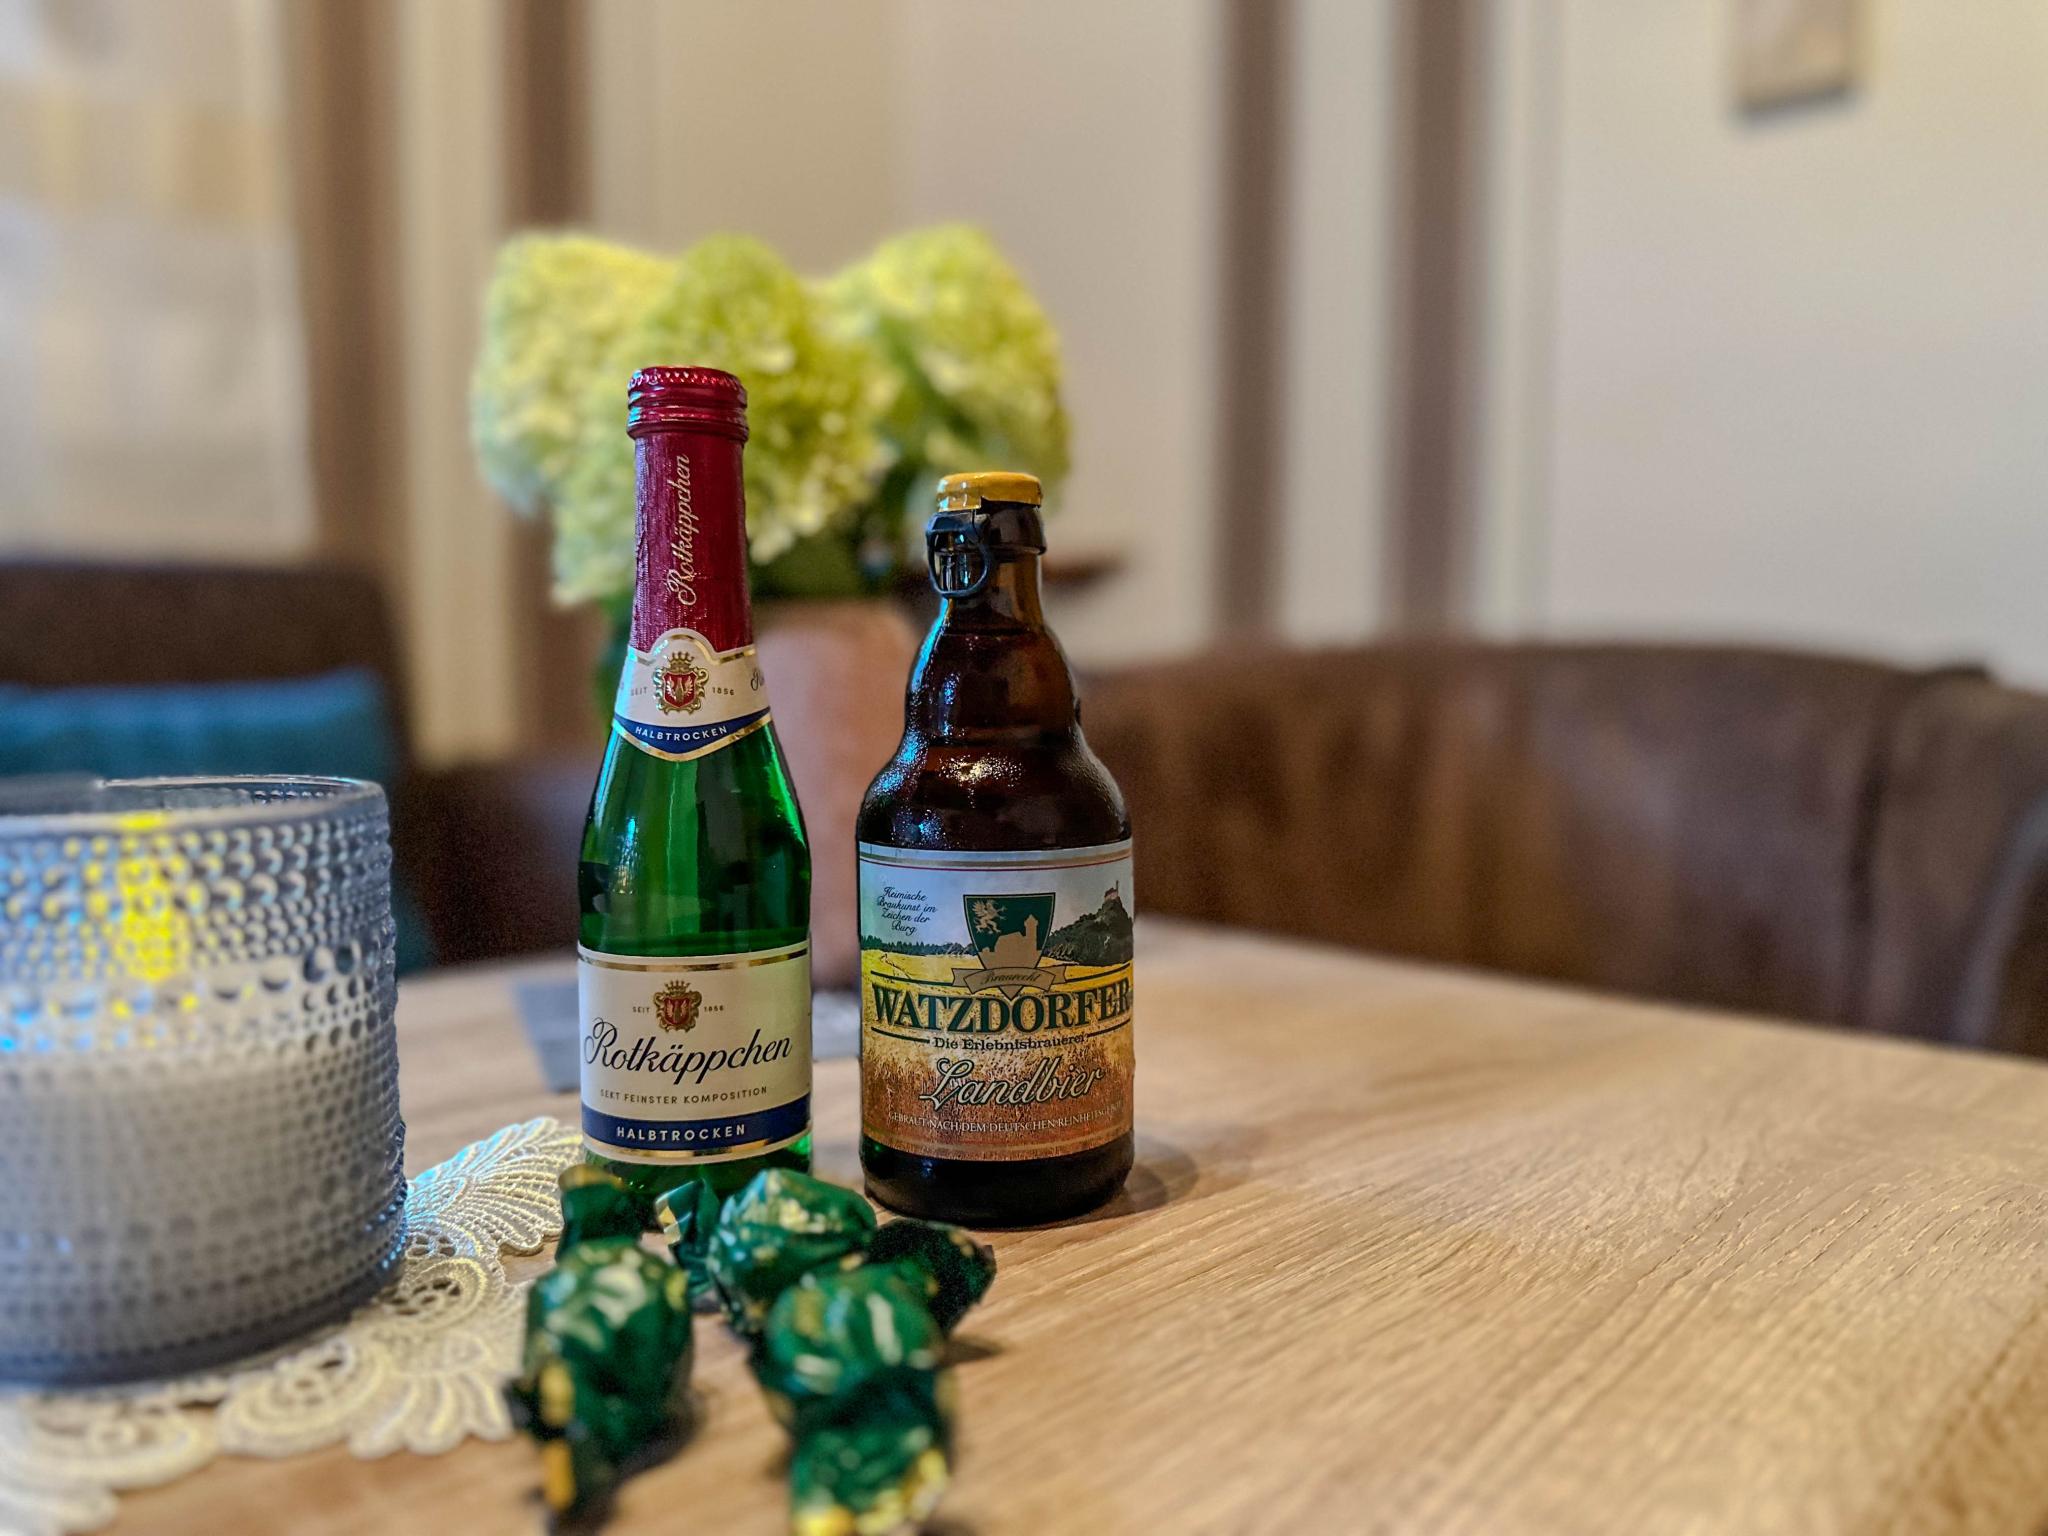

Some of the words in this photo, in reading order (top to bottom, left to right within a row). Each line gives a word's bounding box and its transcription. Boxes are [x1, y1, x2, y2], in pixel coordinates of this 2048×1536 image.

[667, 453, 702, 606] Rotkäppchen
[631, 686, 648, 696] SEIT
[635, 726, 728, 741] HALBTROCKEN
[884, 886, 928, 901] Heimische
[877, 896, 921, 911] Braukunst
[923, 903, 937, 913] im
[881, 907, 911, 921] Zeichen
[914, 911, 931, 923] der
[892, 920, 916, 936] Burg
[632, 1006, 650, 1014] SEIT
[871, 976, 1131, 1033] WATZDORFER
[584, 1017, 793, 1085] Rotkäppchen
[934, 1036, 959, 1049] Die
[962, 1034, 1086, 1051] Erlebnisbrauerei
[919, 1055, 1105, 1111] Landbier
[600, 1088, 620, 1100] SEKT
[624, 1093, 677, 1105] FEINSTER
[683, 1086, 768, 1104] KOMPOSITION
[889, 1112, 927, 1126] GEBRAUT
[929, 1118, 959, 1132] NACH
[961, 1121, 987, 1133] DEM
[989, 1119, 1056, 1133] DEUTSCHEN
[617, 1124, 746, 1142] HALBTROCKEN
